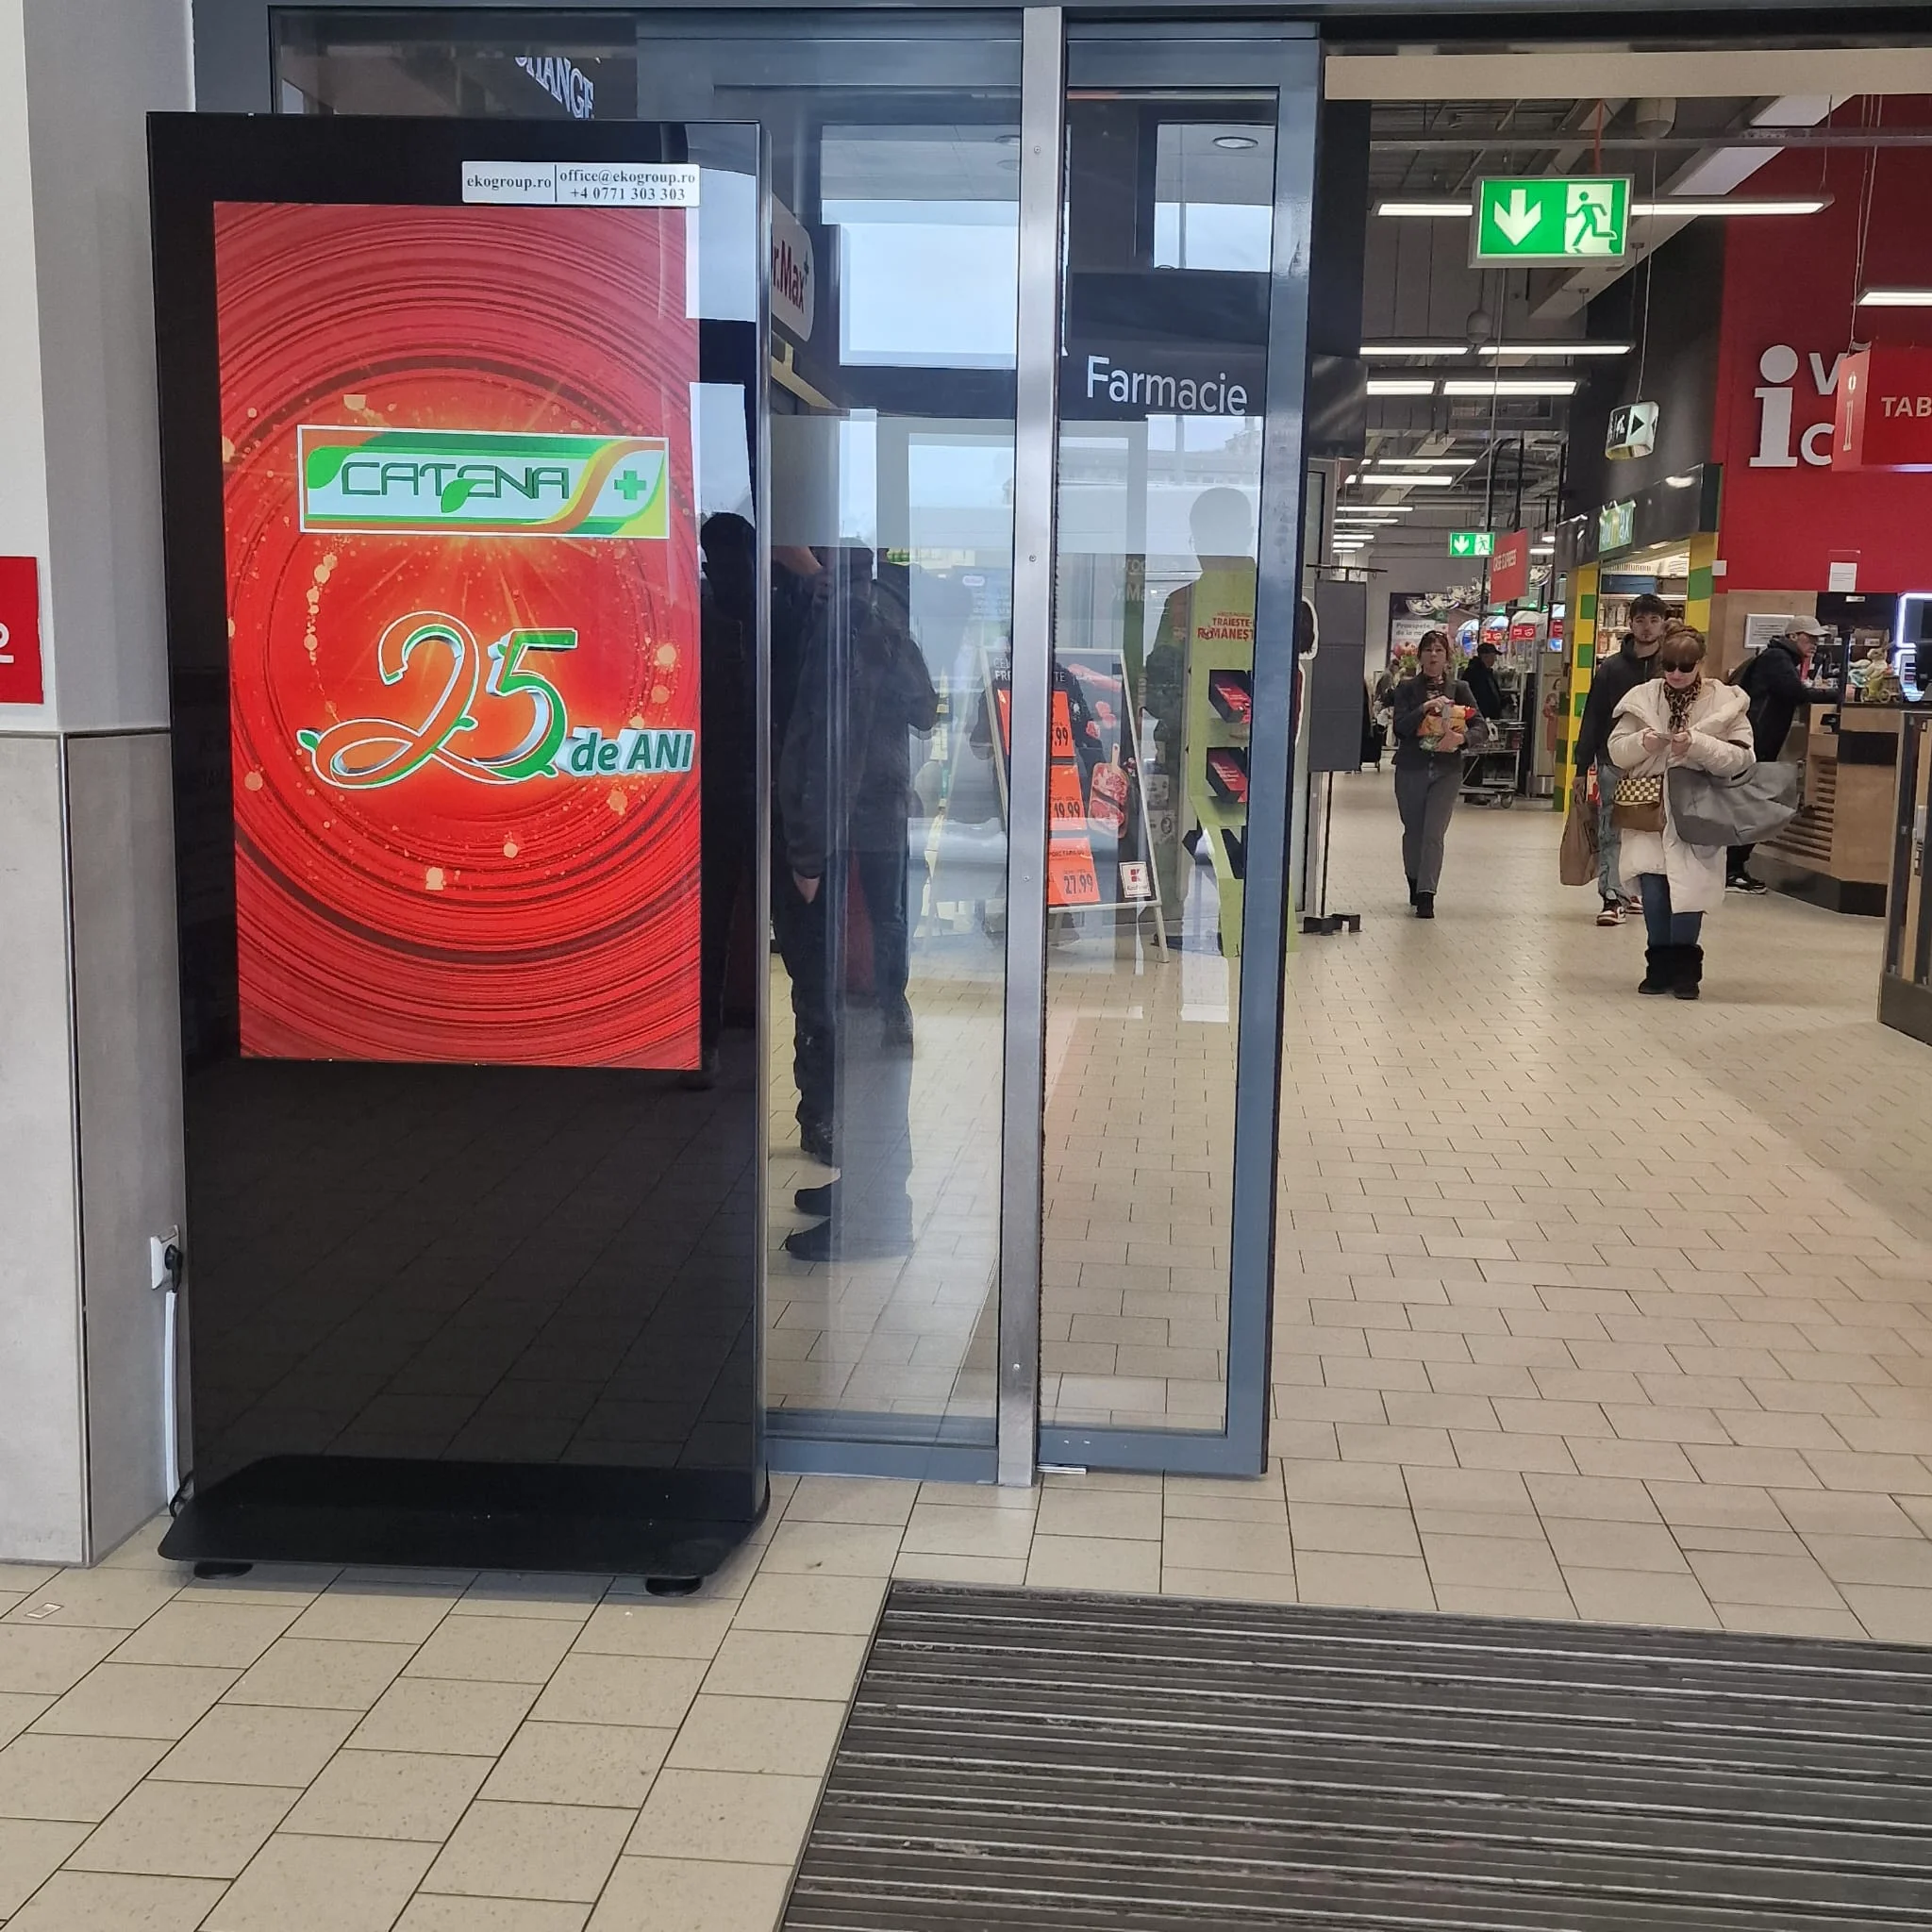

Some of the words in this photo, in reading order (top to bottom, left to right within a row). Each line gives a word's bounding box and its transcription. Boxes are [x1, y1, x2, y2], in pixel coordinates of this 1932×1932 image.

[514, 57, 594, 119] ANGE
[466, 174, 552, 192] ekogroup.ro
[559, 170, 696, 186] office@ekogroup.ro
[570, 186, 589, 200] +4
[592, 187, 625, 201] 0771
[629, 187, 657, 201] 303
[660, 188, 686, 201] 303
[773, 239, 805, 314] r.Max
[1087, 355, 1248, 416] Farmacie
[341, 460, 570, 501] CATENA
[1053, 671, 1066, 682] TE
[296, 609, 579, 791] 25
[569, 728, 619, 775] de
[625, 728, 696, 774] ANI
[1054, 725, 1070, 747] .99
[1054, 800, 1081, 820] 19.99
[1063, 873, 1094, 895] 27.99
